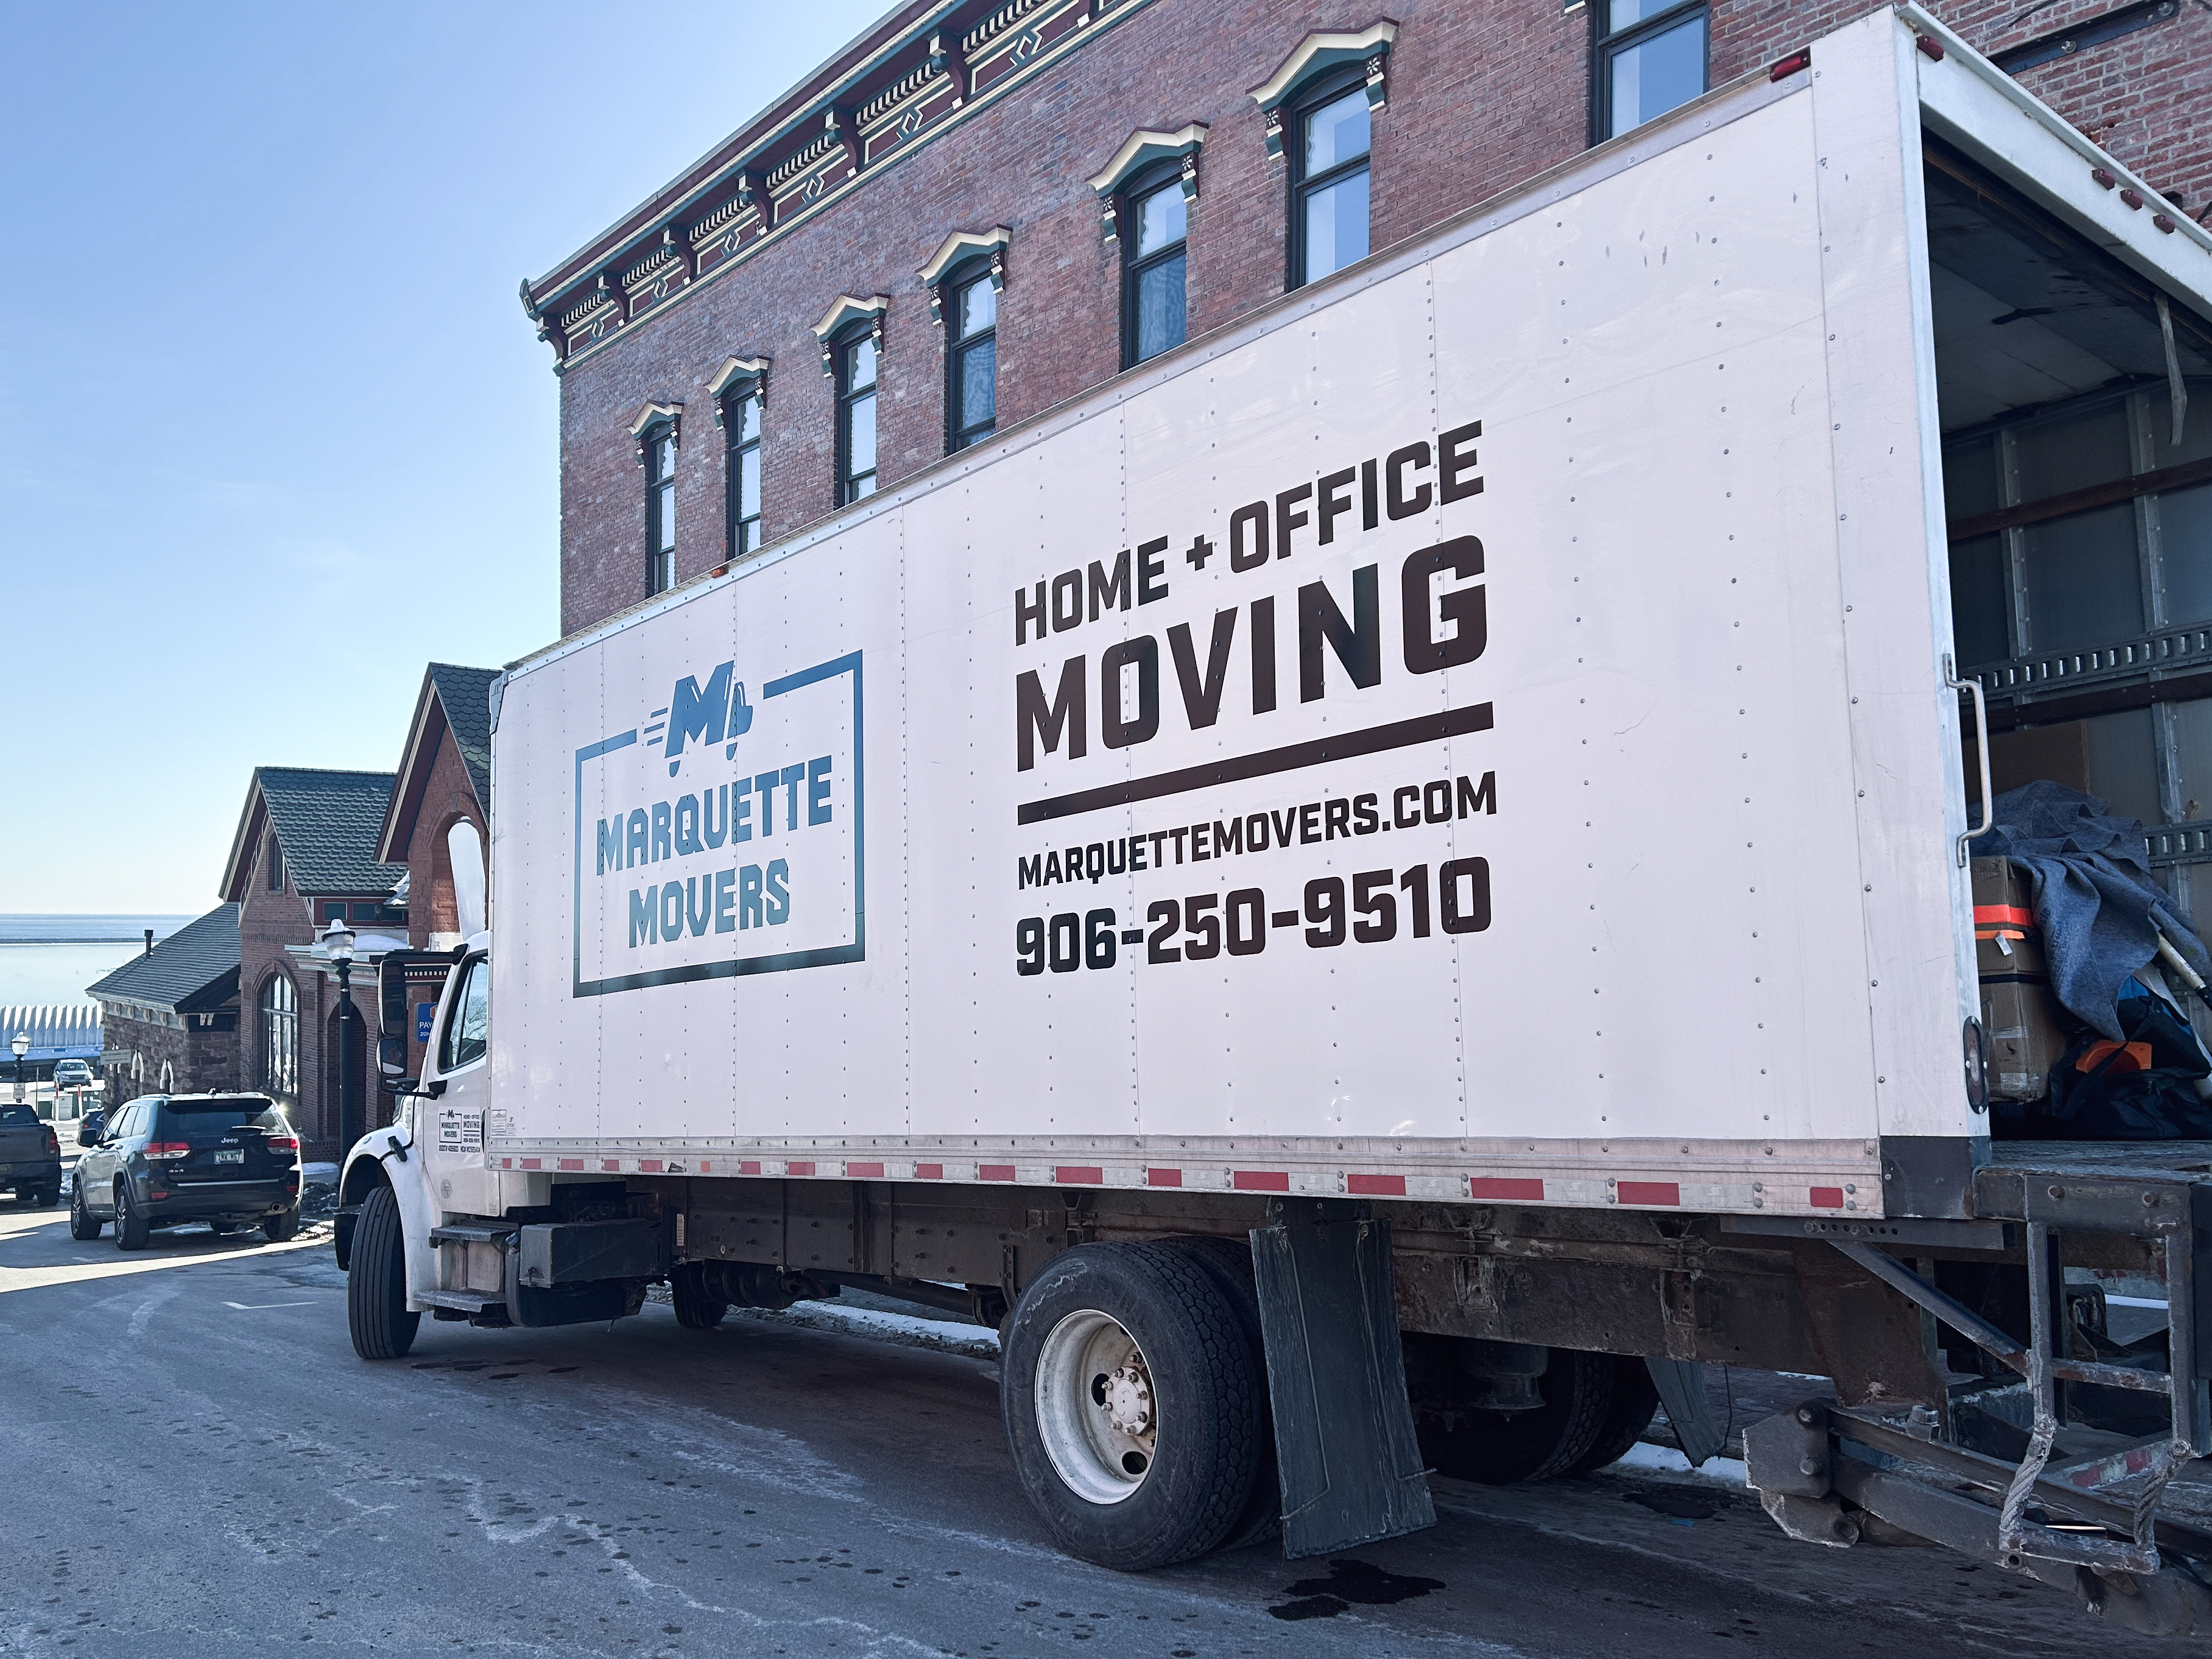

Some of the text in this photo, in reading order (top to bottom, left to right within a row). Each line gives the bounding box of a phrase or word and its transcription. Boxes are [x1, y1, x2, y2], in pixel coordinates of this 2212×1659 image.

[1015, 420, 1484, 647] HOME + OFFICE
[1016, 535, 1487, 773] MOVING
[596, 755, 833, 878] MARQUETTE
[1019, 770, 1497, 890] MARQUETTEMOVERS.COM
[629, 858, 790, 949] MOVERS
[1017, 856, 1492, 976] 906-250-9510
